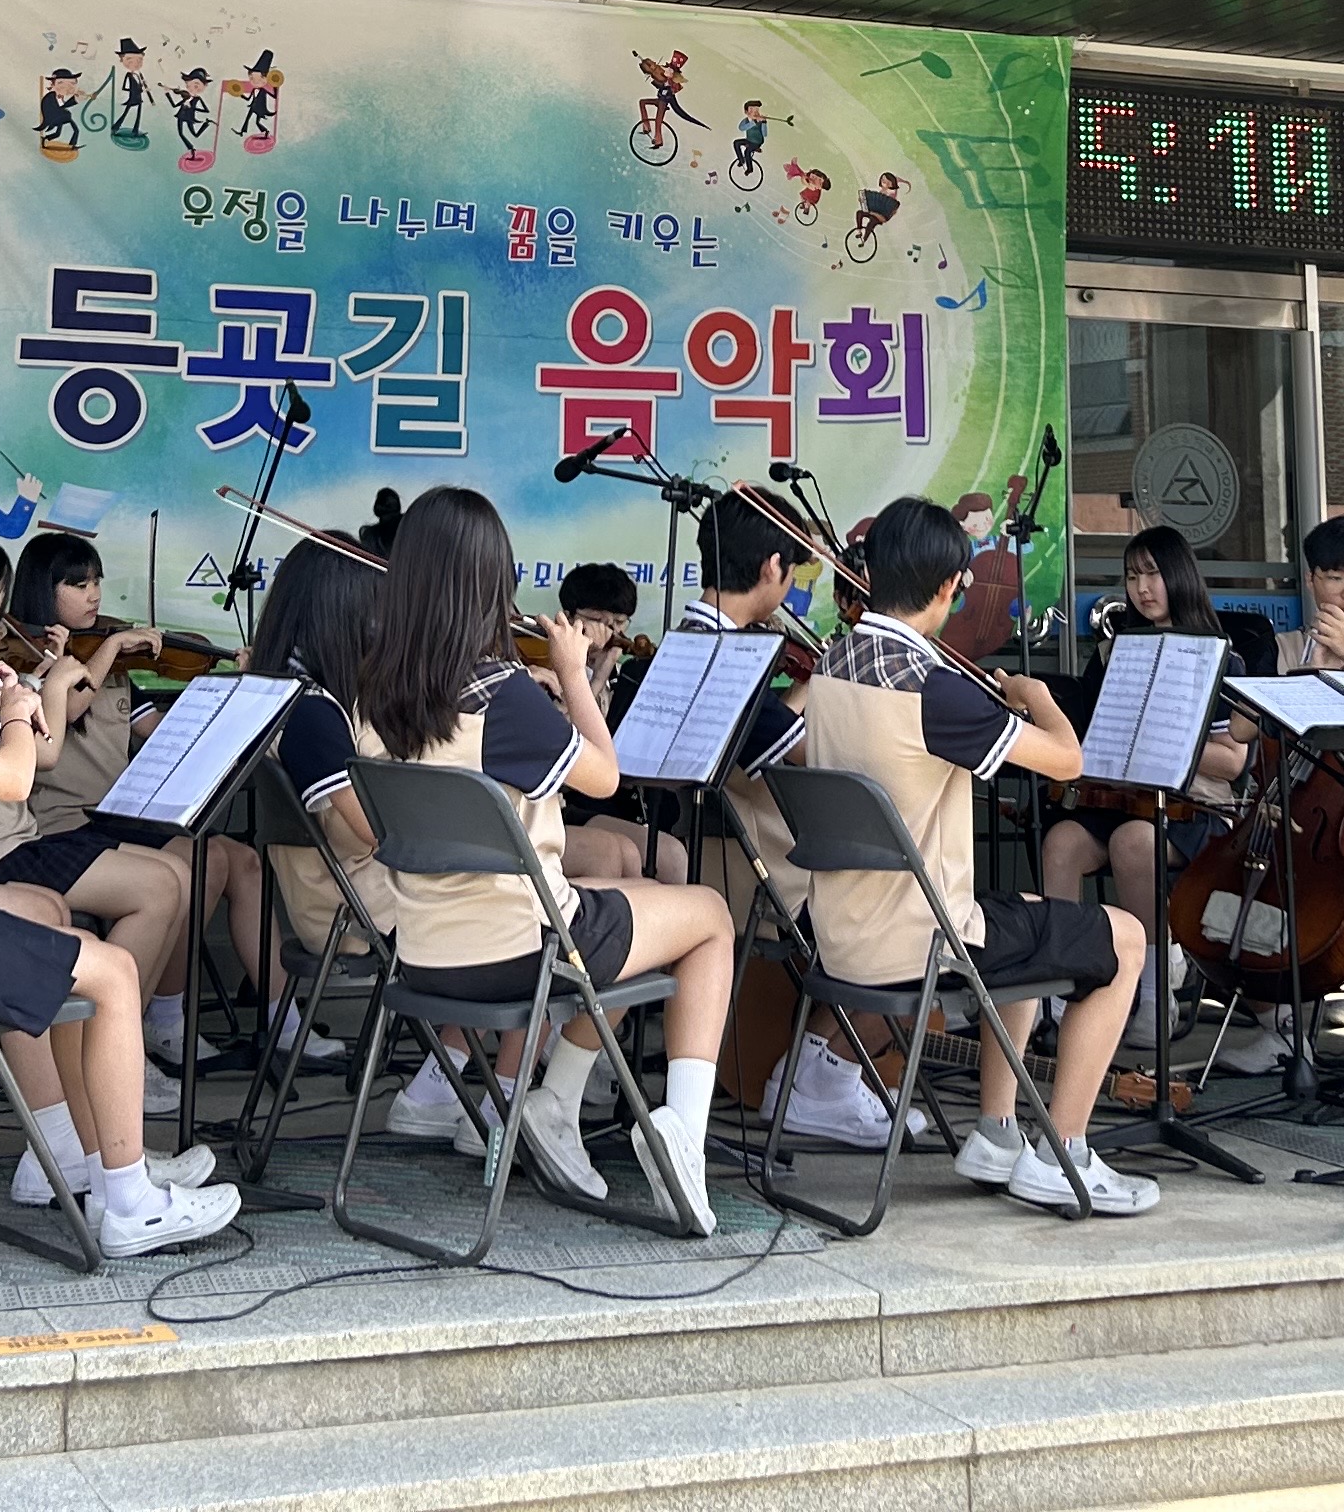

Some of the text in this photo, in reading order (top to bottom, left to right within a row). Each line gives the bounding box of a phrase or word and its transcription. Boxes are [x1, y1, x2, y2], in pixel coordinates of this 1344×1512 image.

[181, 184, 720, 269] 우정을 나누며 꿈을 키우는
[15, 264, 931, 465] 등굣길 음악회
